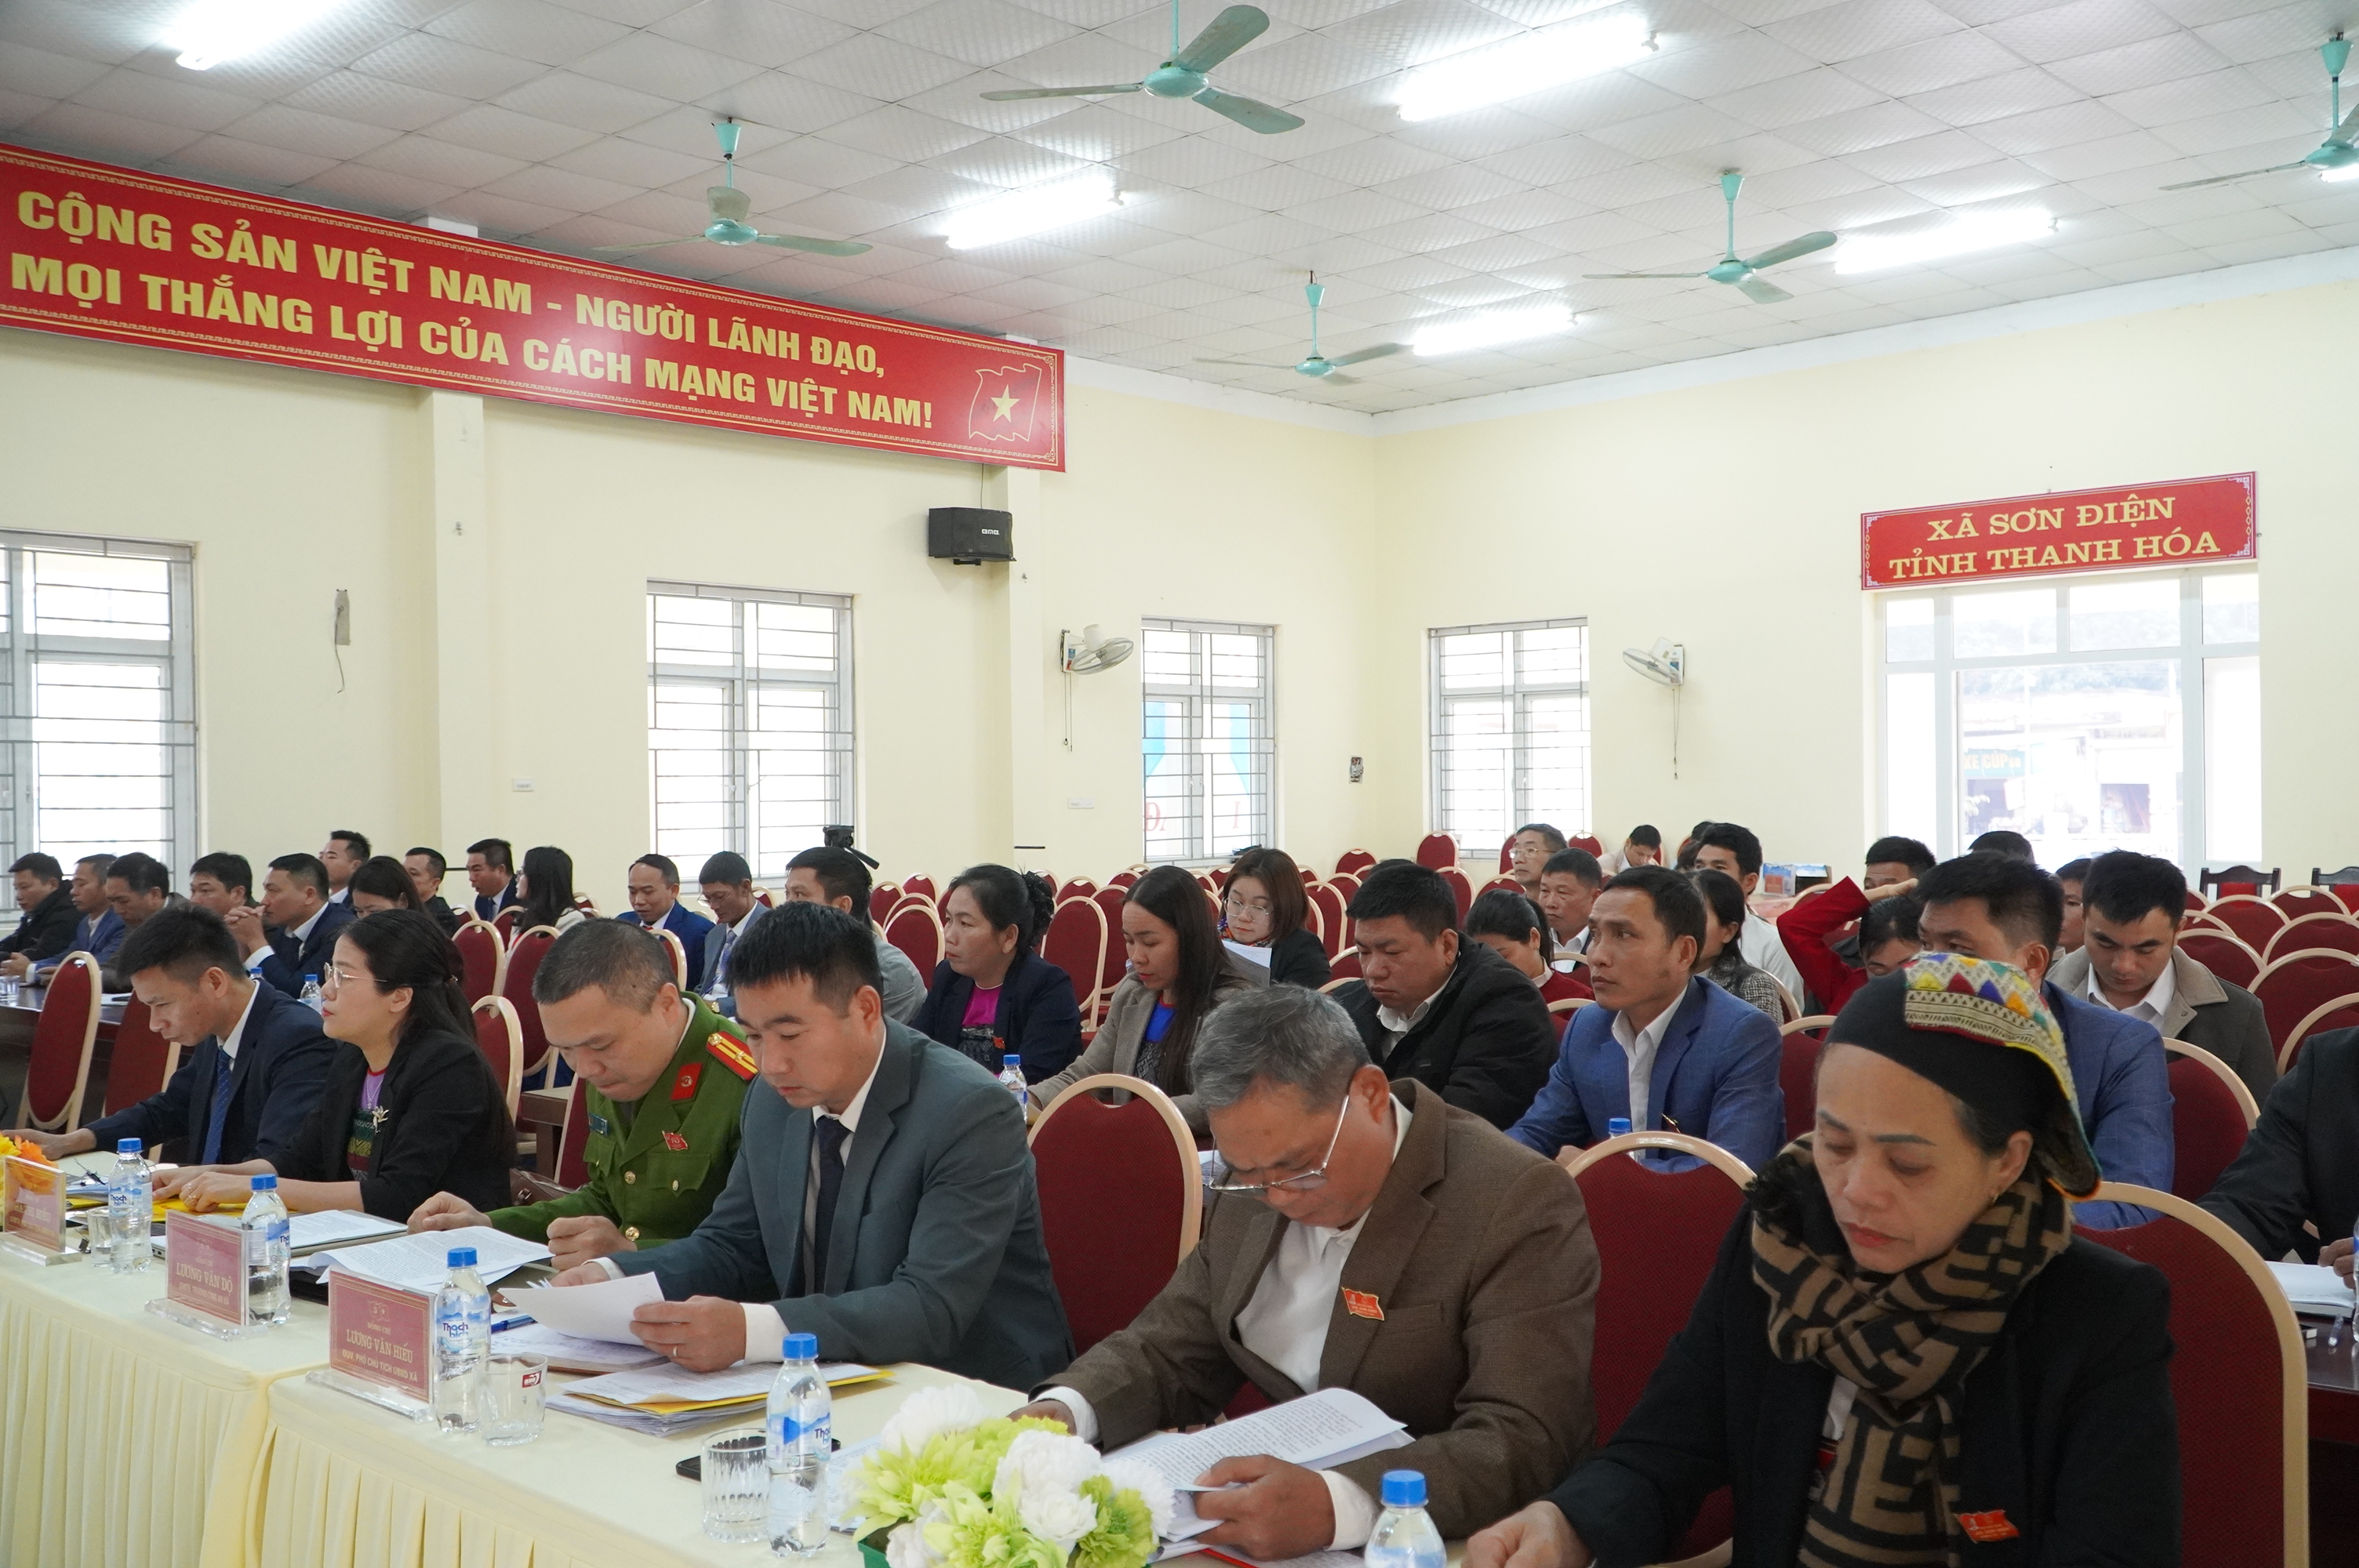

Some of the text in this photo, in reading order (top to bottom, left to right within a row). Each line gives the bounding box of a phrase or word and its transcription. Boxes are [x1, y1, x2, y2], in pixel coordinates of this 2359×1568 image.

[17, 191, 172, 252] CỘNG
[191, 219, 298, 274] SẢN
[314, 244, 415, 296] VIỆT
[430, 267, 532, 315] NAM
[576, 293, 695, 343] NGƯỜI
[708, 316, 800, 361] LÃNH
[810, 336, 885, 377] ĐẠO,
[11, 253, 932, 428] MỌI THẮNG LỢI CỦA CÁCH MẠNG VIỆT NAM!
[1927, 494, 2175, 542] XÃ SƠN ĐIỆN
[1889, 527, 2220, 579] TỈNH THANH HÓA
[347, 1329, 413, 1363] LƯƠNG VĂN HIẾU
